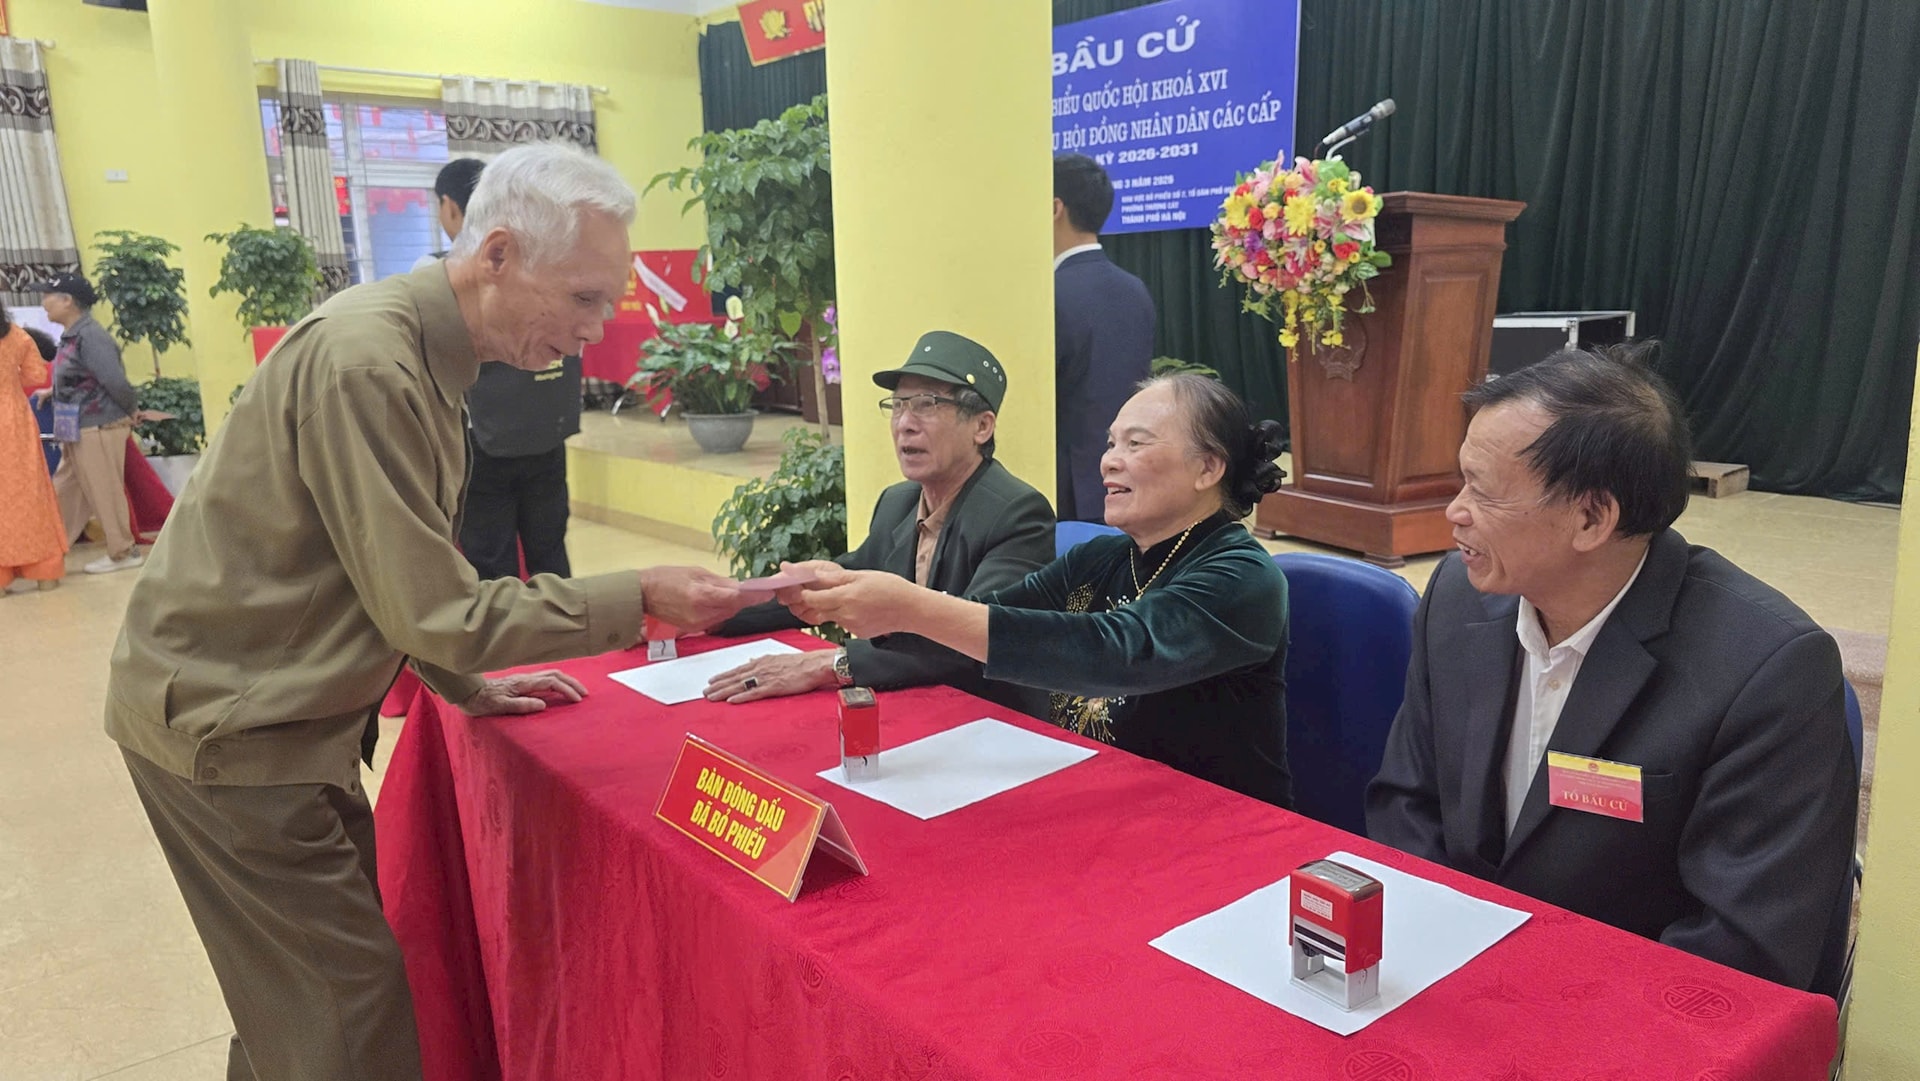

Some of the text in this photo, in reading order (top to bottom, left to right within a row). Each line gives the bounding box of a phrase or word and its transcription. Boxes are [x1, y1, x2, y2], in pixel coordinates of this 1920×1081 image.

[1052, 15, 1200, 76] BẦU CỬ
[1052, 68, 1228, 117] BIỂU QUỐC HỘI KHOÁ XVI
[1062, 123, 1086, 152] HỘI
[1089, 115, 1128, 146] ĐỒNG
[1130, 111, 1173, 140] NHÂN
[1176, 106, 1210, 134] DÂN
[1212, 100, 1245, 129] CÁC
[1247, 90, 1281, 124] CẤP
[1118, 142, 1198, 163] 2026-2031
[1124, 179, 1130, 189] 3
[1131, 175, 1151, 188] NĂM
[1152, 174, 1174, 186] 2026
[696, 767, 786, 832] BÀN ĐÓNG DẤU
[1563, 787, 1628, 812] TỔ BẦU CỬ
[690, 800, 767, 860] ĐÃ BỎ PHIẾU
